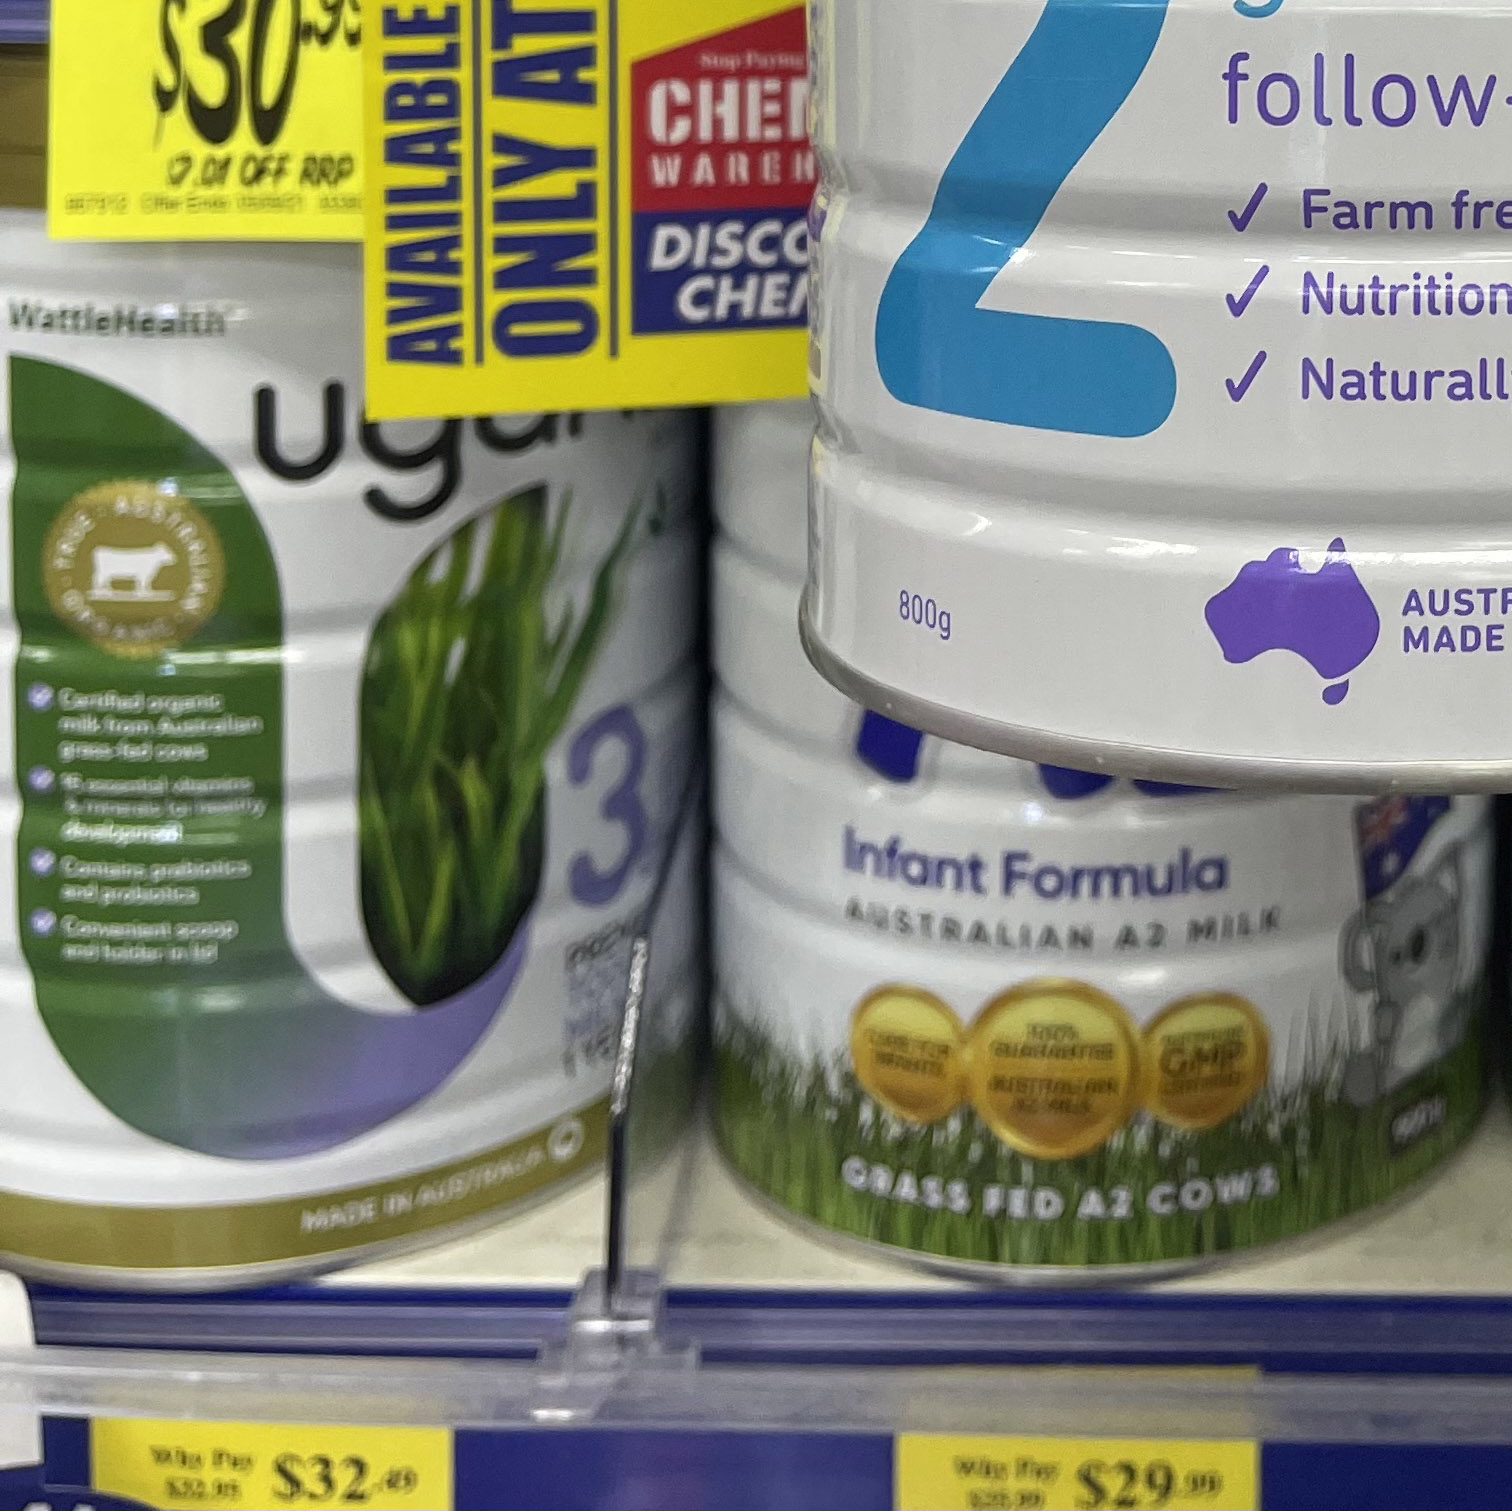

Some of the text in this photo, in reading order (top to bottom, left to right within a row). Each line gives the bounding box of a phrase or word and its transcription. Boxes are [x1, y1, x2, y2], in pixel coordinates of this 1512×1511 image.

[239, 152, 355, 187] OFF RRP
[381, 2, 466, 366] AVAILABLE
[491, 112, 600, 360] ONLY
[1300, 187, 1436, 234] Farm
[9, 302, 226, 337] WattleHealth
[897, 587, 954, 642] 800g
[1402, 623, 1506, 655] MADE
[568, 702, 648, 908] 3
[842, 824, 1230, 901] Infant Formula
[843, 895, 1283, 952] AUSTRALIAN A2 MILK
[301, 1144, 548, 1241] MADE IN AUSTRALIA
[840, 1155, 1279, 1221] GRASS FED A2 COWS
